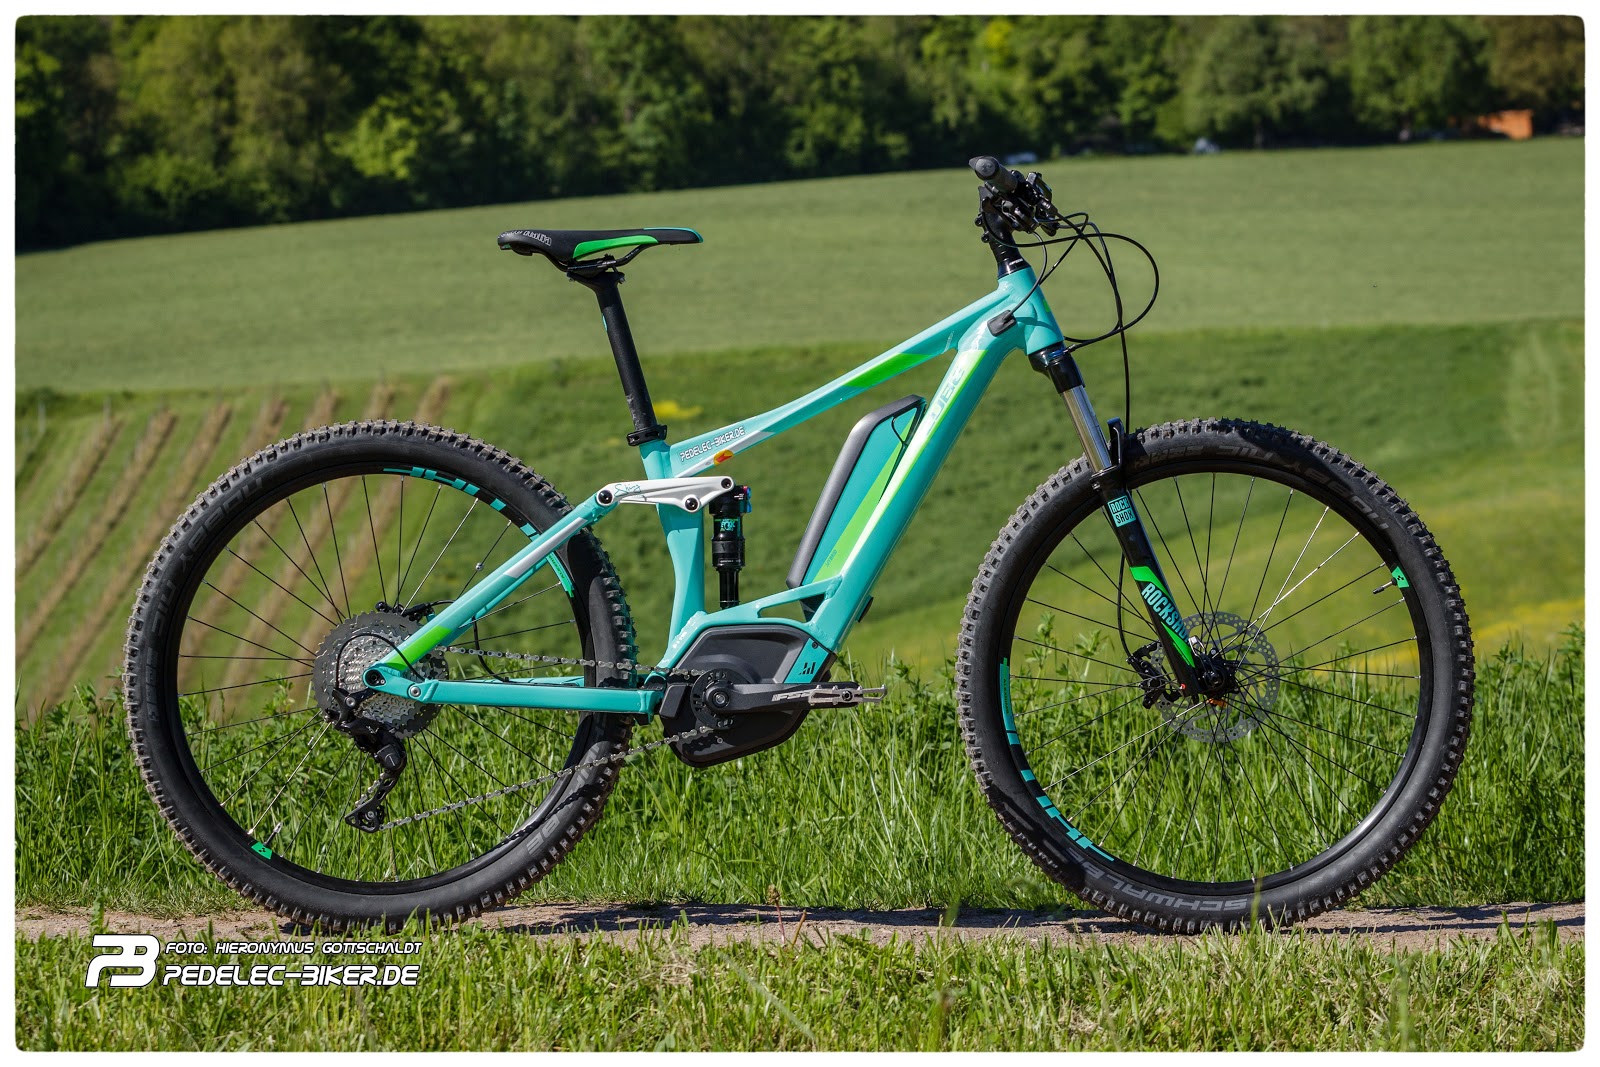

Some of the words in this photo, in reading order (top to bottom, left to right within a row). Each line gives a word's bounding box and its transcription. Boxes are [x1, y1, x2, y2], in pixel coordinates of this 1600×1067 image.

[680, 427, 746, 463] PEDELEC-BIKER.DE
[1110, 498, 1130, 513] ROCK
[1115, 510, 1134, 524] SHOX
[180, 477, 264, 573] NOBBY
[720, 520, 736, 532] FOX
[1067, 847, 1248, 912] SCHWALBE
